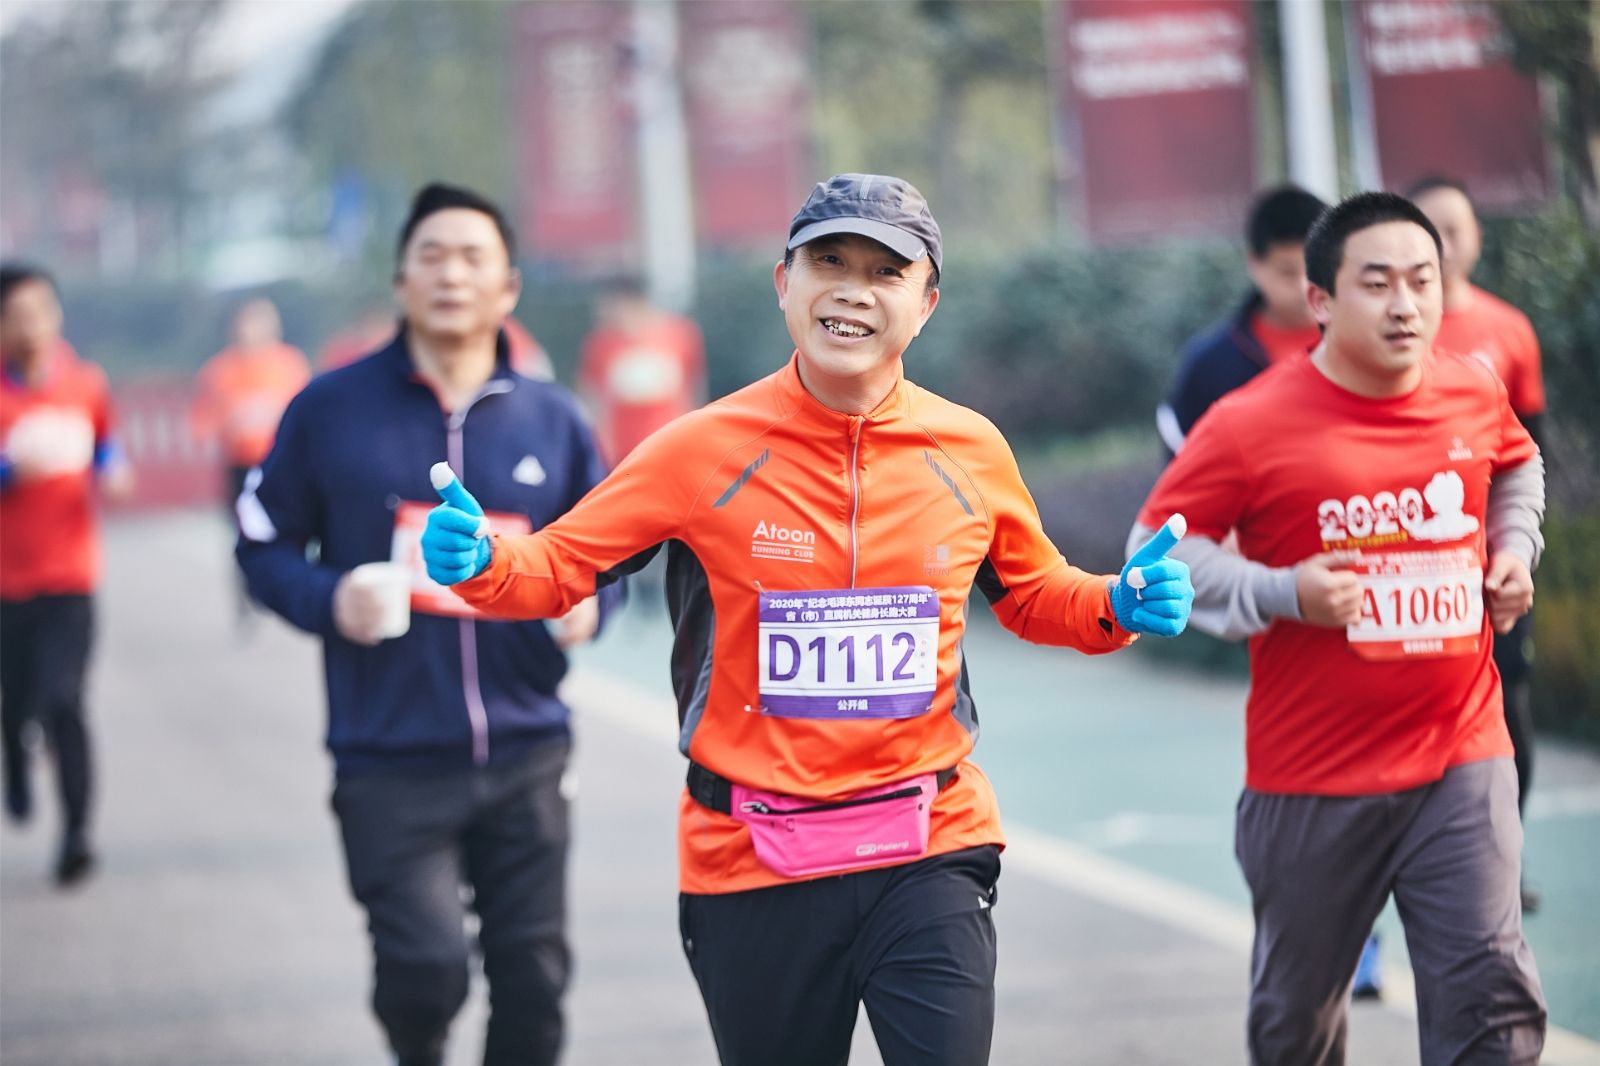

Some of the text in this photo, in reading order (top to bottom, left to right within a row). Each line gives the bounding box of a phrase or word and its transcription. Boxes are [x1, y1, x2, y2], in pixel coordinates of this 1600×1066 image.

[752, 519, 815, 544] Atoon
[1318, 487, 1423, 542] 2020
[752, 545, 814, 559] RUNNING CLUB
[1361, 584, 1469, 627] A1060
[769, 631, 916, 683] D1112
[837, 699, 868, 711] 公开组
